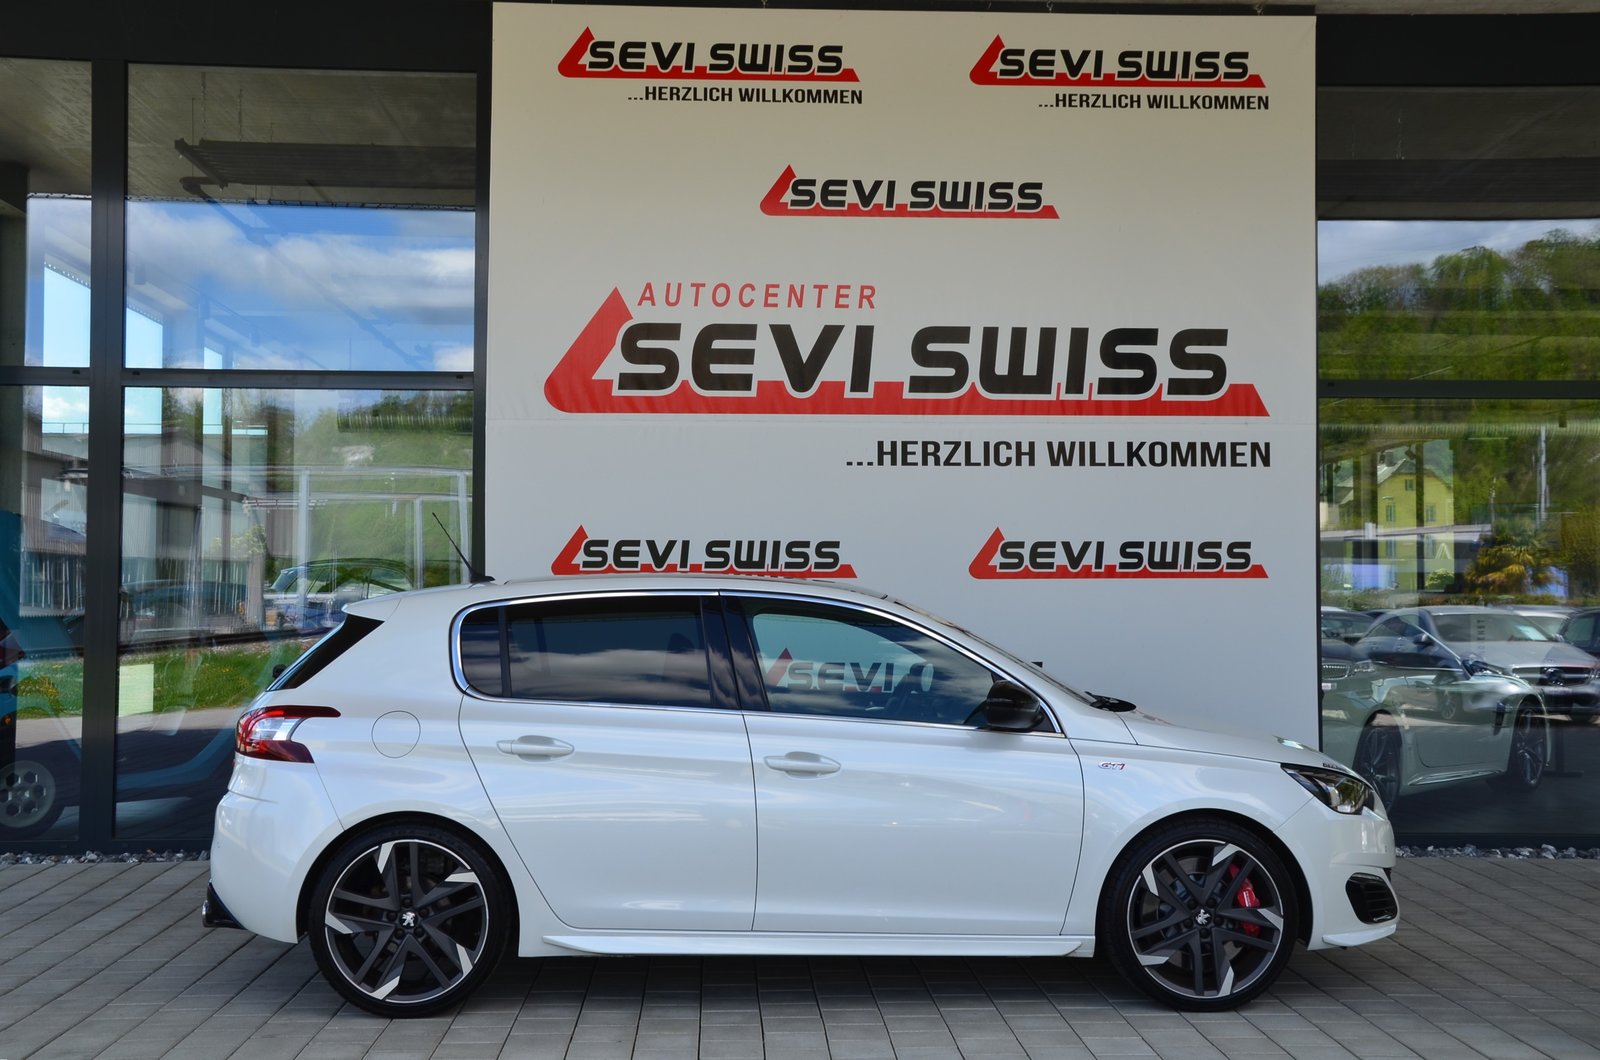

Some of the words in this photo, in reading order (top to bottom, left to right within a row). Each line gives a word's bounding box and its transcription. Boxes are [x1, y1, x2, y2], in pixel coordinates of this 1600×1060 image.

[588, 40, 696, 71] SEVI
[708, 42, 844, 74] SWISS
[999, 48, 1104, 78] SEVI
[1116, 50, 1250, 81] SWISS
[627, 85, 733, 102] ...HERZLICH
[738, 87, 863, 105] WILLKOMMEN
[1038, 93, 1141, 109] ...HERZLICH
[1146, 94, 1269, 110] WILLKOMMEN
[789, 178, 897, 209] SEVI
[909, 180, 1043, 211] SWISS
[637, 281, 877, 310] AUTOCENTER
[617, 322, 875, 393] SEVI
[908, 325, 1229, 396] SWISS
[846, 440, 1036, 467] ...HERZLICH
[1046, 441, 1271, 468] WILLKOMMEN
[581, 539, 690, 569] SEVI
[703, 539, 841, 571] SWISS
[998, 540, 1105, 570] SEVI
[1118, 541, 1252, 572] SWISS
[785, 661, 893, 693] SEVI
